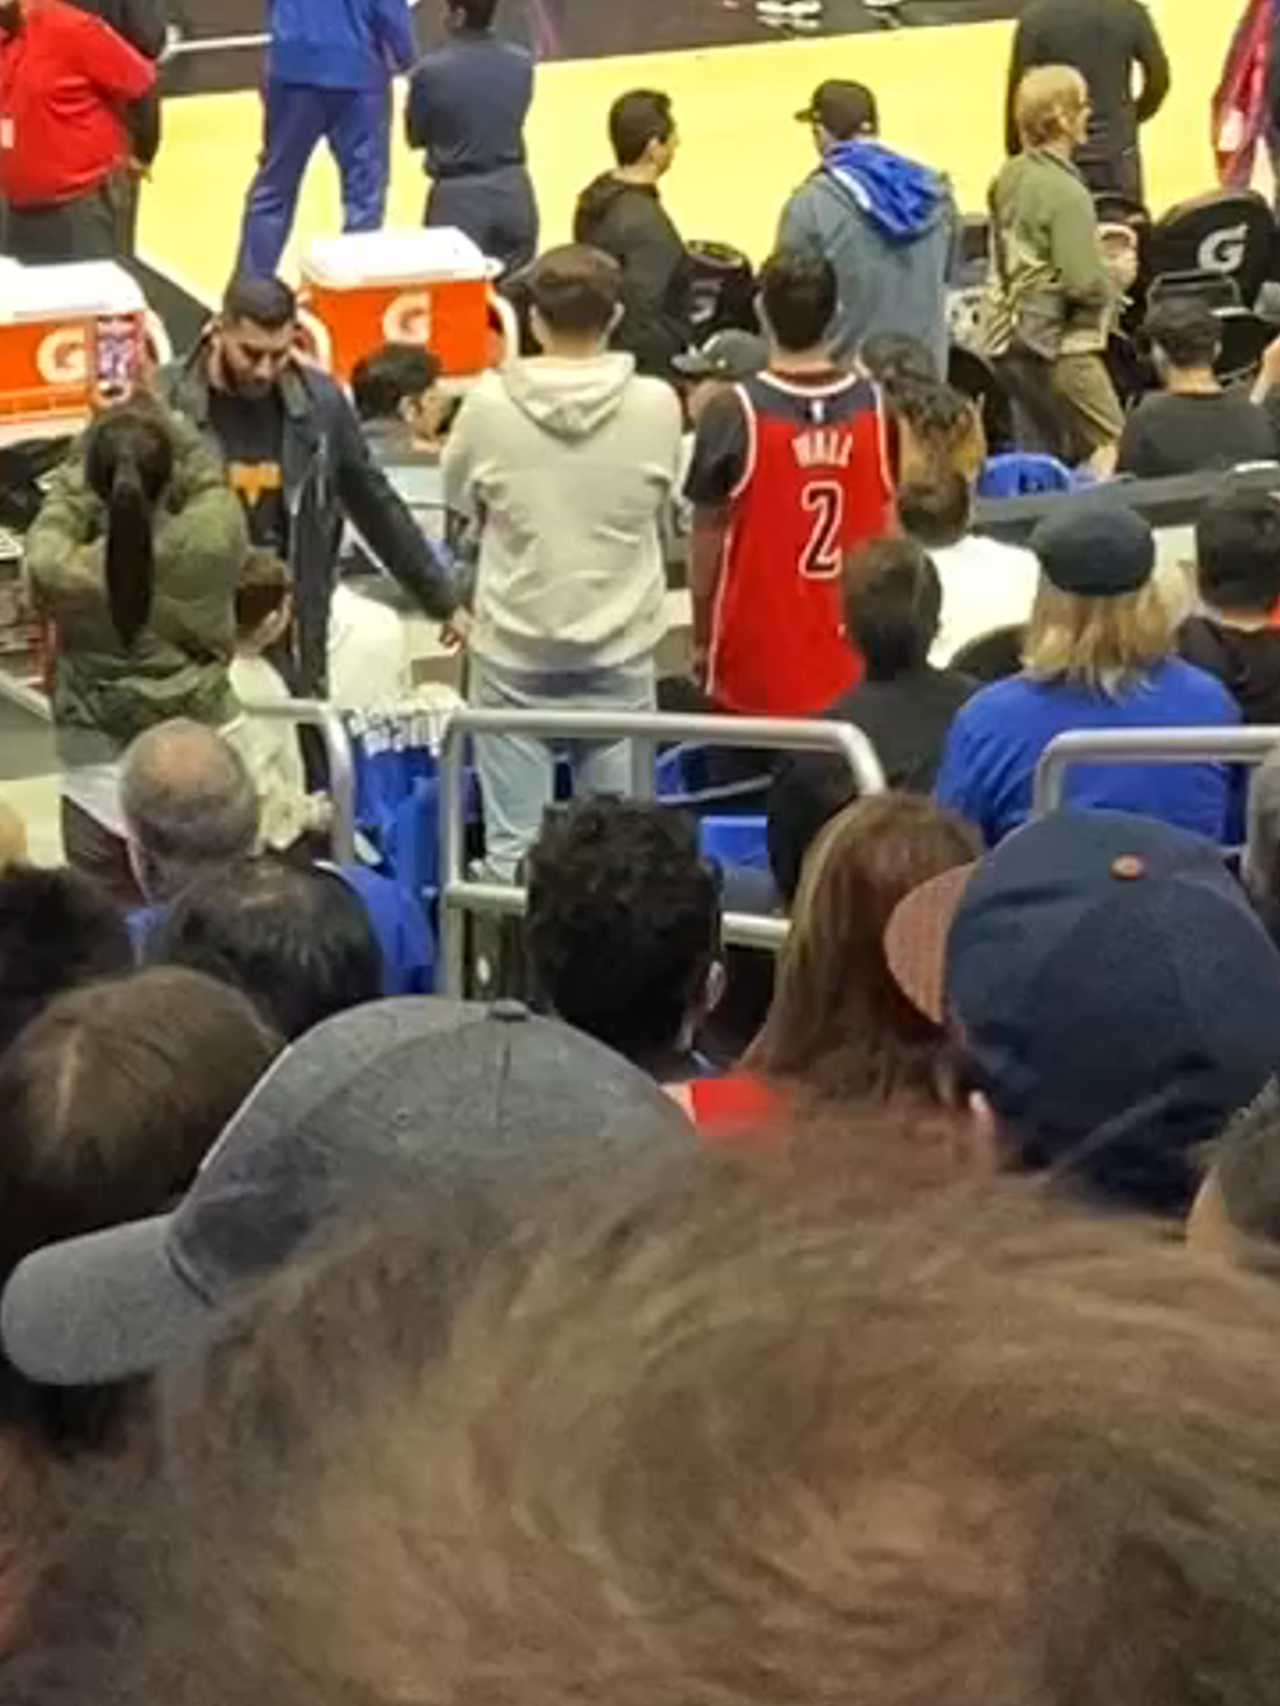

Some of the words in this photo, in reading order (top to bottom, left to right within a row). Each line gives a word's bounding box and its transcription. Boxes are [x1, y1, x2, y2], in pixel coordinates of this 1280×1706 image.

[1199, 223, 1249, 272] G
[381, 294, 431, 346] G
[37, 329, 89, 384] G
[790, 429, 853, 468] WALL
[797, 480, 843, 579] 2
